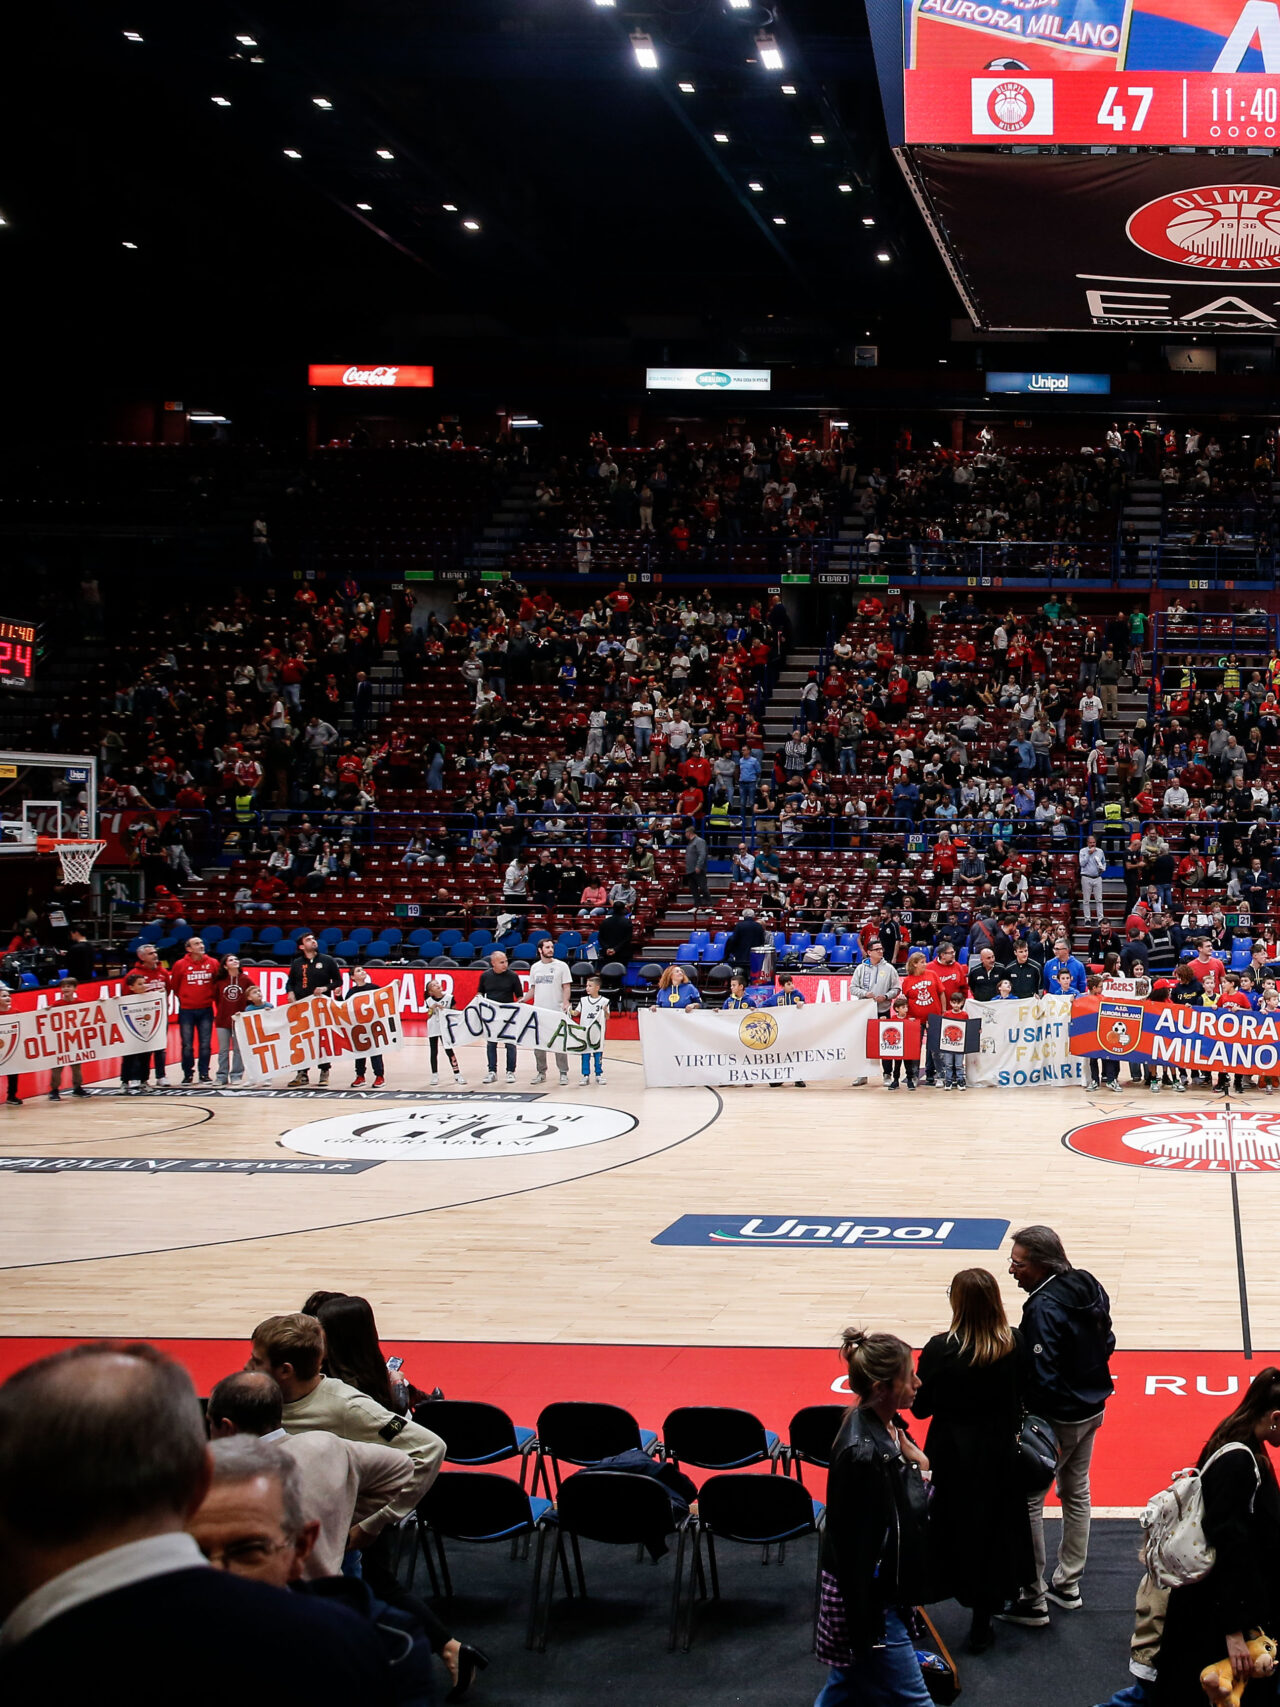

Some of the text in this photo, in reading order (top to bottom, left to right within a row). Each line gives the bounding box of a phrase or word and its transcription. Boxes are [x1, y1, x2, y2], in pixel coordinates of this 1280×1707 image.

[1027, 14, 1120, 47] MILANO
[1097, 86, 1154, 132] 47
[1211, 87, 1277, 123] 11:40
[1091, 317, 1220, 328] EMPORIO
[1030, 374, 1069, 392] Unipol
[1, 623, 35, 643] 11:40
[408, 906, 419, 915] 19
[1105, 980, 1134, 992] TIGERS
[35, 1005, 107, 1035] FORZA
[242, 986, 397, 1046] IL SANGA
[445, 1002, 540, 1045] FORZA
[1100, 1010, 1121, 1018] AURORA
[1154, 1007, 1279, 1041] AURORA
[24, 1023, 125, 1060] OLIMPIA
[289, 1016, 398, 1066] STANGA!
[57, 1050, 96, 1065] MILANO
[673, 1047, 846, 1068] VIRTUS ABBIATENSE
[1151, 1035, 1278, 1070] MILANO
[729, 1066, 795, 1082] BASKET
[394, 1091, 523, 1101] EYEWEAR
[404, 1112, 586, 1123] ACQUA DI
[323, 1138, 535, 1147] GIORGIO ARMANI
[194, 1161, 353, 1173] EYEWEAR
[739, 1218, 955, 1244] Unipol
